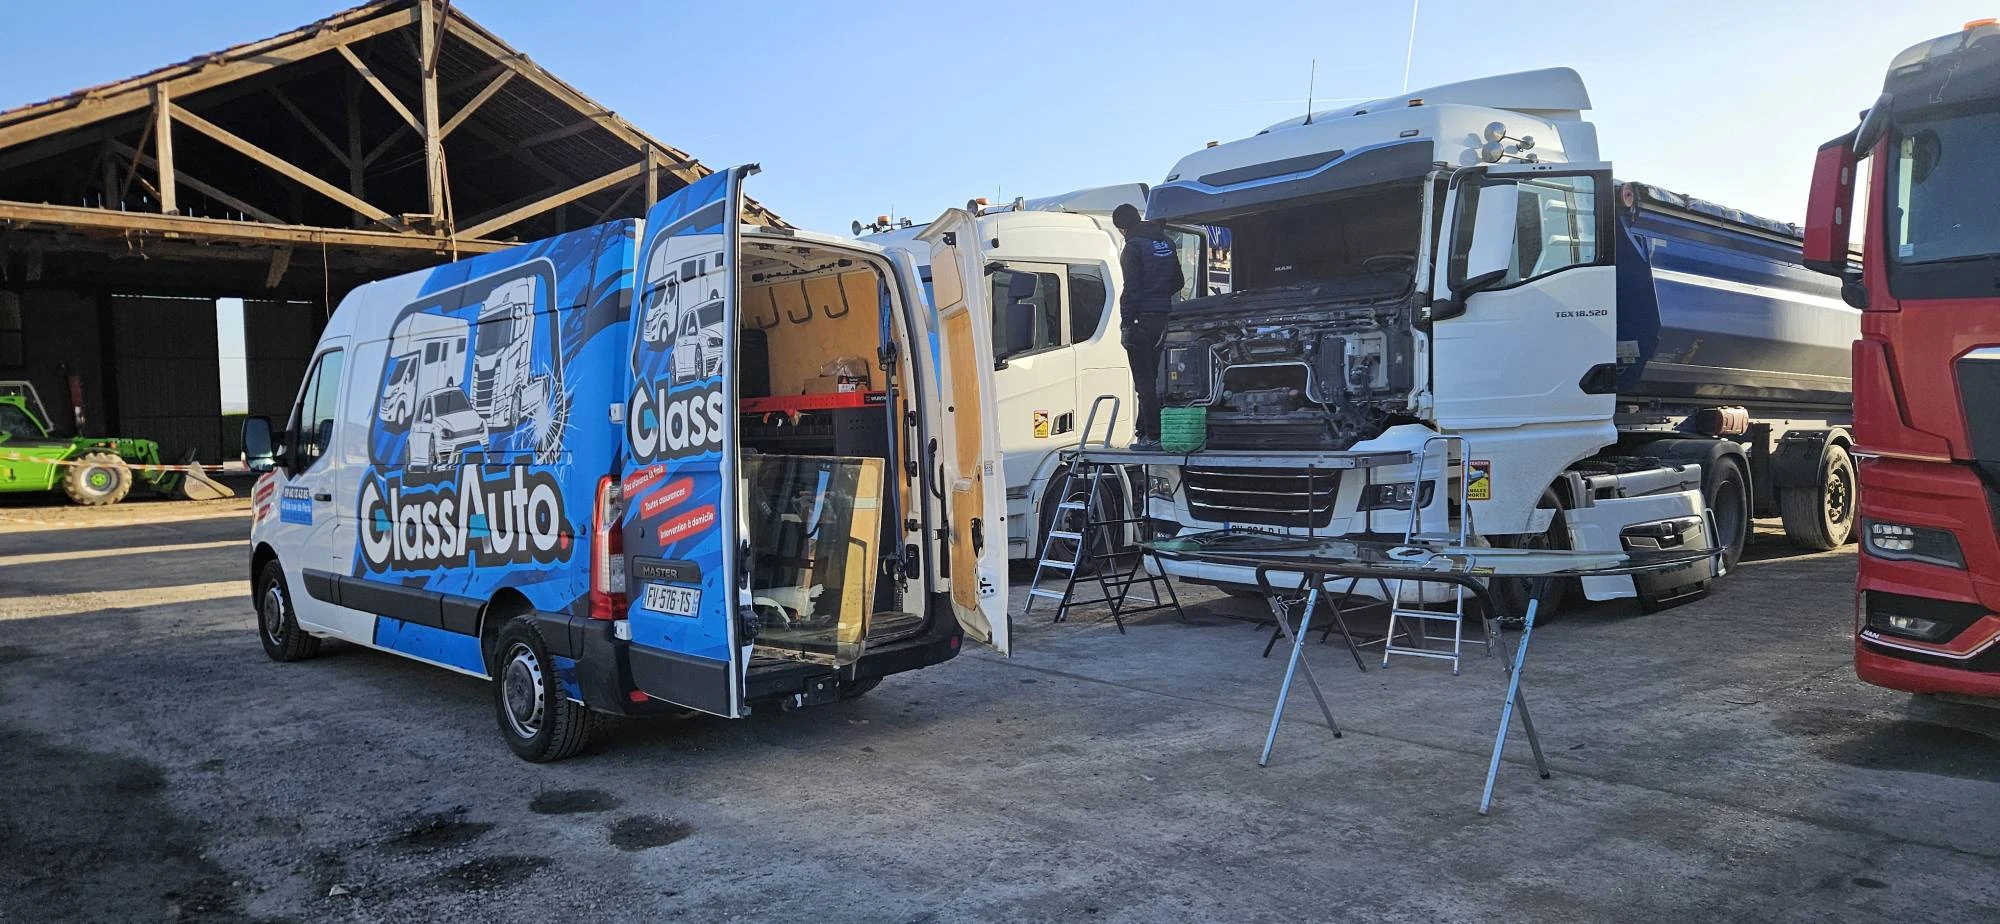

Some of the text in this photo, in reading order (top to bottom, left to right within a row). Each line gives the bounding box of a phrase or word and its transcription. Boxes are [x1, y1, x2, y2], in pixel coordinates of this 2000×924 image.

[1575, 309, 1608, 317] 18.520
[631, 386, 723, 458] Glass
[644, 487, 685, 512] Toutes assurances
[660, 522, 687, 539] Intervention
[691, 511, 714, 527] domicile
[642, 566, 678, 578] MASTER
[646, 586, 692, 613] FV-576-TS
